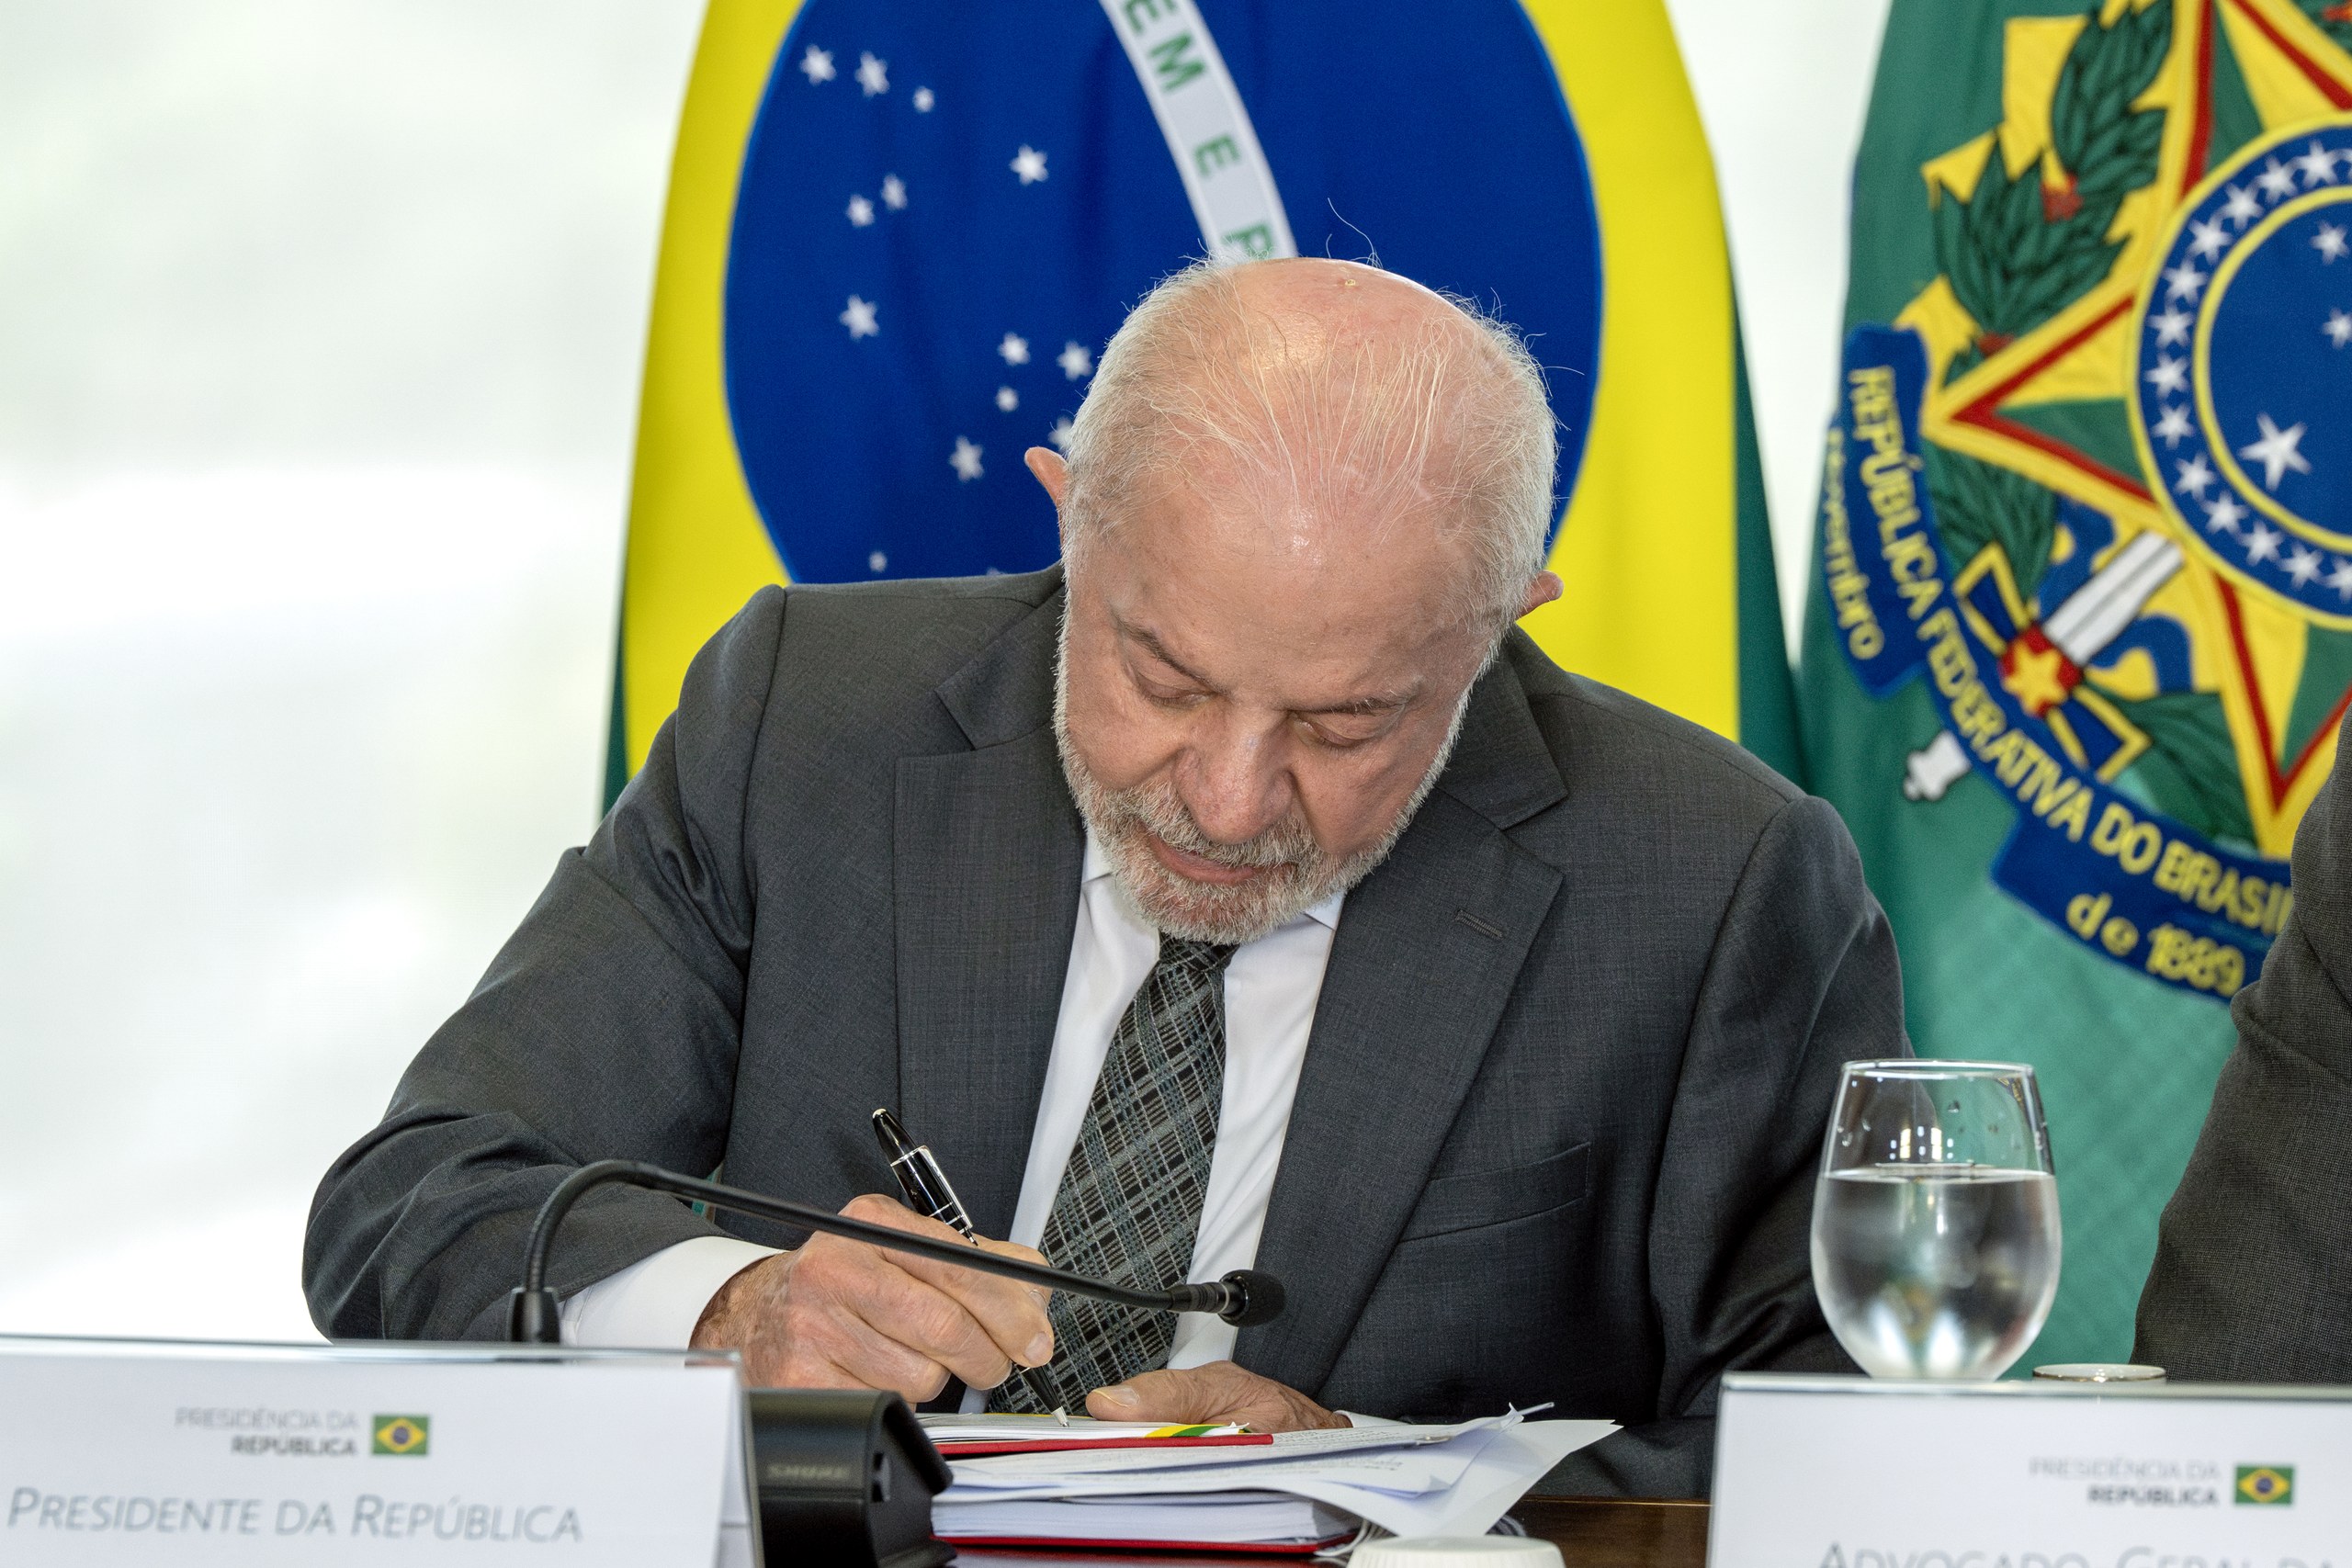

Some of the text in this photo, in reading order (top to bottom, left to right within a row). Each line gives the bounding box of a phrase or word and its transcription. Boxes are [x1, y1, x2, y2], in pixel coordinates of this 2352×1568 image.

[1193, 133, 1242, 180] E
[1848, 365, 1944, 621] REPÚBLICA
[1917, 605, 2094, 843] FEDERATIVA
[2089, 802, 2163, 875] DO
[2065, 891, 2245, 998] de 1889
[175, 1406, 360, 1430] PRESIDÊNCIA DA
[232, 1432, 358, 1457] REPÚBLICA
[7, 1486, 264, 1535] PRESIDENTE
[275, 1498, 337, 1536] DA
[2086, 1482, 2220, 1507] REPÚBLICA
